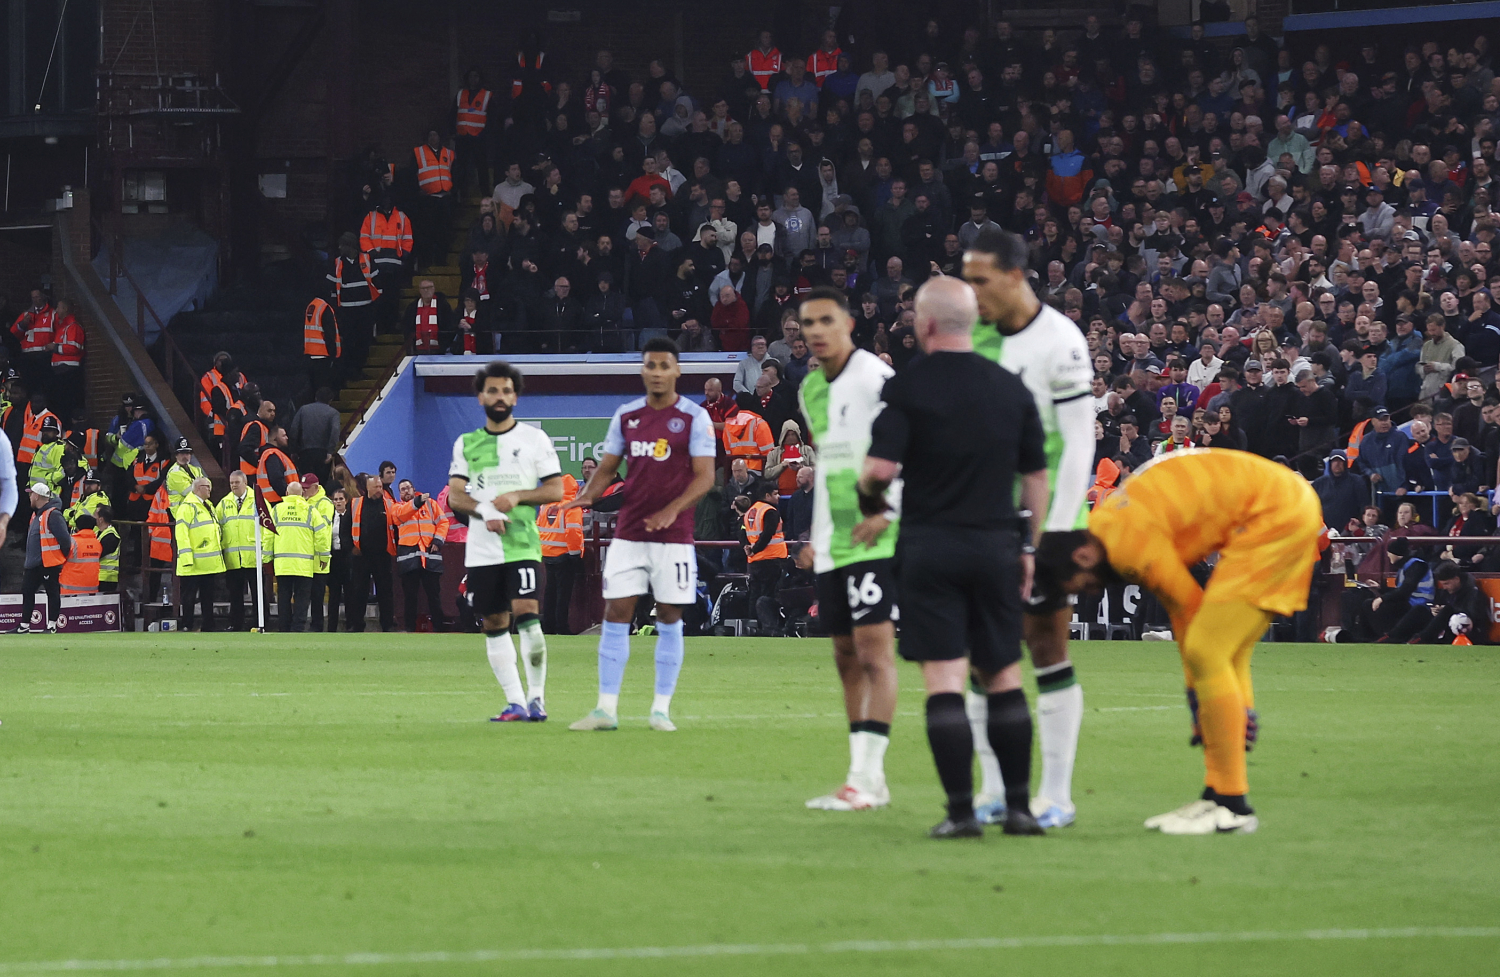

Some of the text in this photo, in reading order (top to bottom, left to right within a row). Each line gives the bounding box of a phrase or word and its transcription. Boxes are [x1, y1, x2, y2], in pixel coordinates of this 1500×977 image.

[551, 436, 608, 462] Fire
[517, 567, 537, 590] 11
[847, 571, 883, 608] 66
